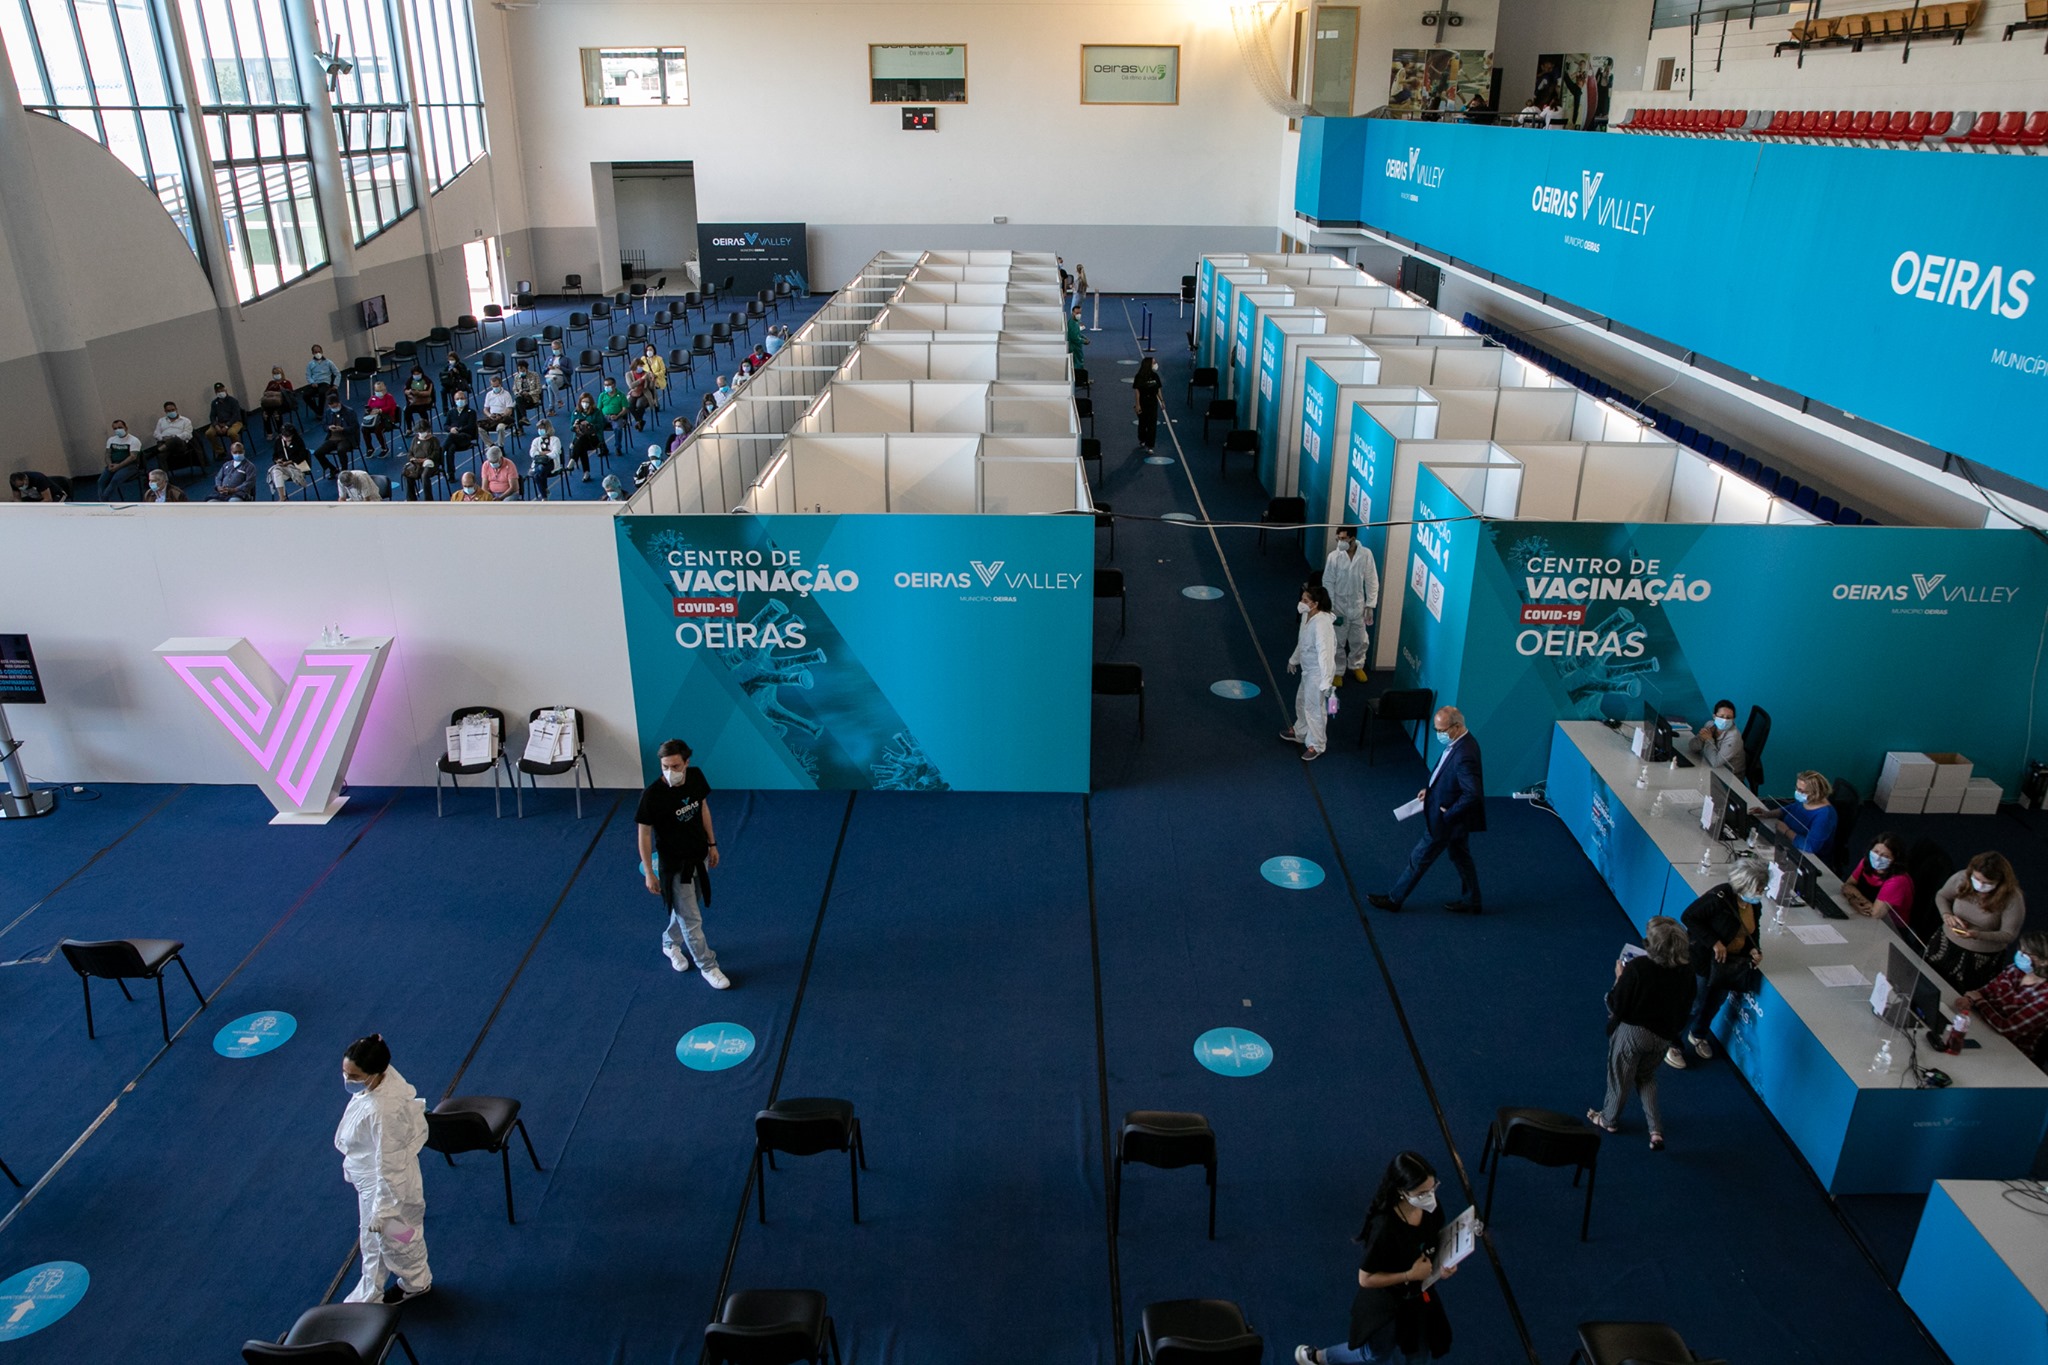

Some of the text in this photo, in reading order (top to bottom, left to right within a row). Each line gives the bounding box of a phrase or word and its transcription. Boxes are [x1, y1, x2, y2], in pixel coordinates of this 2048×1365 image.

[913, 116, 919, 124] 2
[1385, 158, 1445, 189] OEIRAS VALLEY
[1532, 184, 1655, 236] OEIRAS VALLEY
[712, 237, 791, 246] OEIRAS VALLEY
[1890, 250, 2036, 320] OEIRAS
[1306, 396, 1323, 427] SALA 3
[1352, 447, 1375, 487] SALA 2
[668, 550, 801, 566] CENTRO DE
[1417, 522, 1450, 573] SALA 1
[1527, 557, 1661, 575] CENTRO DE
[669, 563, 860, 598] VACINAÇÃO
[894, 572, 1083, 589] OEIRAS VALLEY
[1526, 573, 1711, 607] VACINAÇÃO
[1832, 584, 2020, 603] OEIRAS VALLEY
[677, 602, 734, 614] COVID-19
[1524, 609, 1582, 621] COVID-19
[675, 622, 807, 649] OEIRAS
[1515, 629, 1648, 657] OEIRAS
[675, 800, 699, 816] OEIRAS
